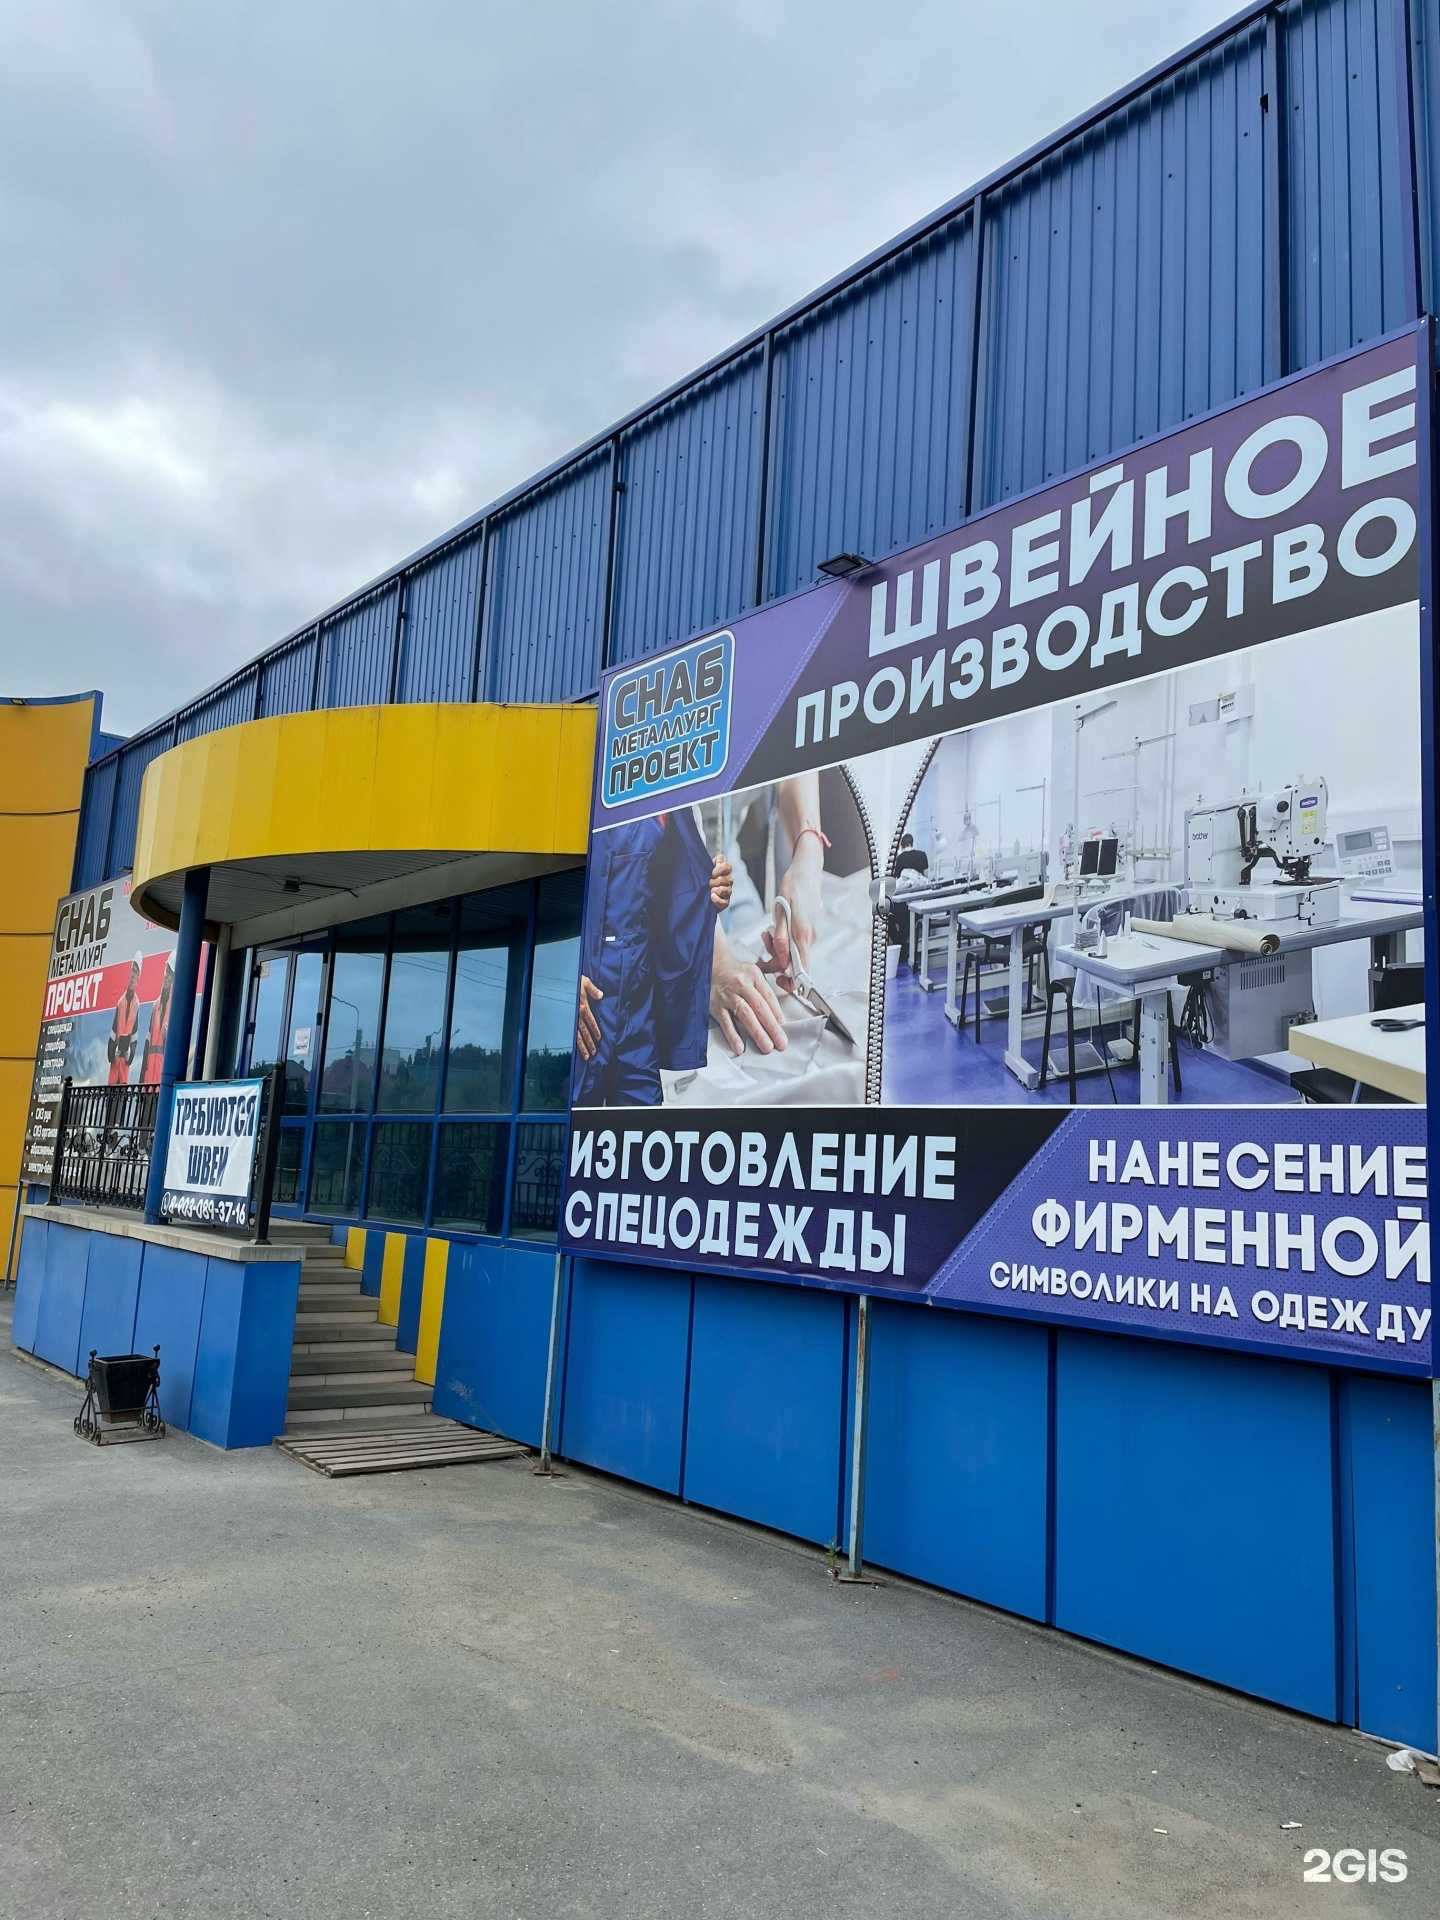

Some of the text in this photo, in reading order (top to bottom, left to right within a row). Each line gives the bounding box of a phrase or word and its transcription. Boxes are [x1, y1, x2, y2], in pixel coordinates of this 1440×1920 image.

[868, 365, 1417, 657] ШВЕЙНОЕ
[795, 497, 1417, 748] ПРОИЗВОДСТВО
[615, 644, 724, 730] СНАБ
[609, 730, 720, 796] ПРОЕКТ
[611, 701, 721, 760] МЕТАЛЛУРГ
[55, 887, 114, 954] СНАБ
[50, 942, 107, 978] МЕТАЛЛУРГ
[45, 972, 103, 1016] ПРОЕКТ
[175, 1095, 258, 1137] ТРЕБУЮТСЯ
[570, 1130, 956, 1200] ИЗГОТОВЛЕНИЕ
[1088, 1140, 1428, 1197] НАНЕСЕНИЕ
[565, 1195, 907, 1276] СПЕЦОДЕЖДЫ
[1031, 1199, 1431, 1284] ФИРМЕННОЙ
[989, 1261, 1181, 1313] СИМВОЛИКИ
[1190, 1282, 1238, 1318] НА
